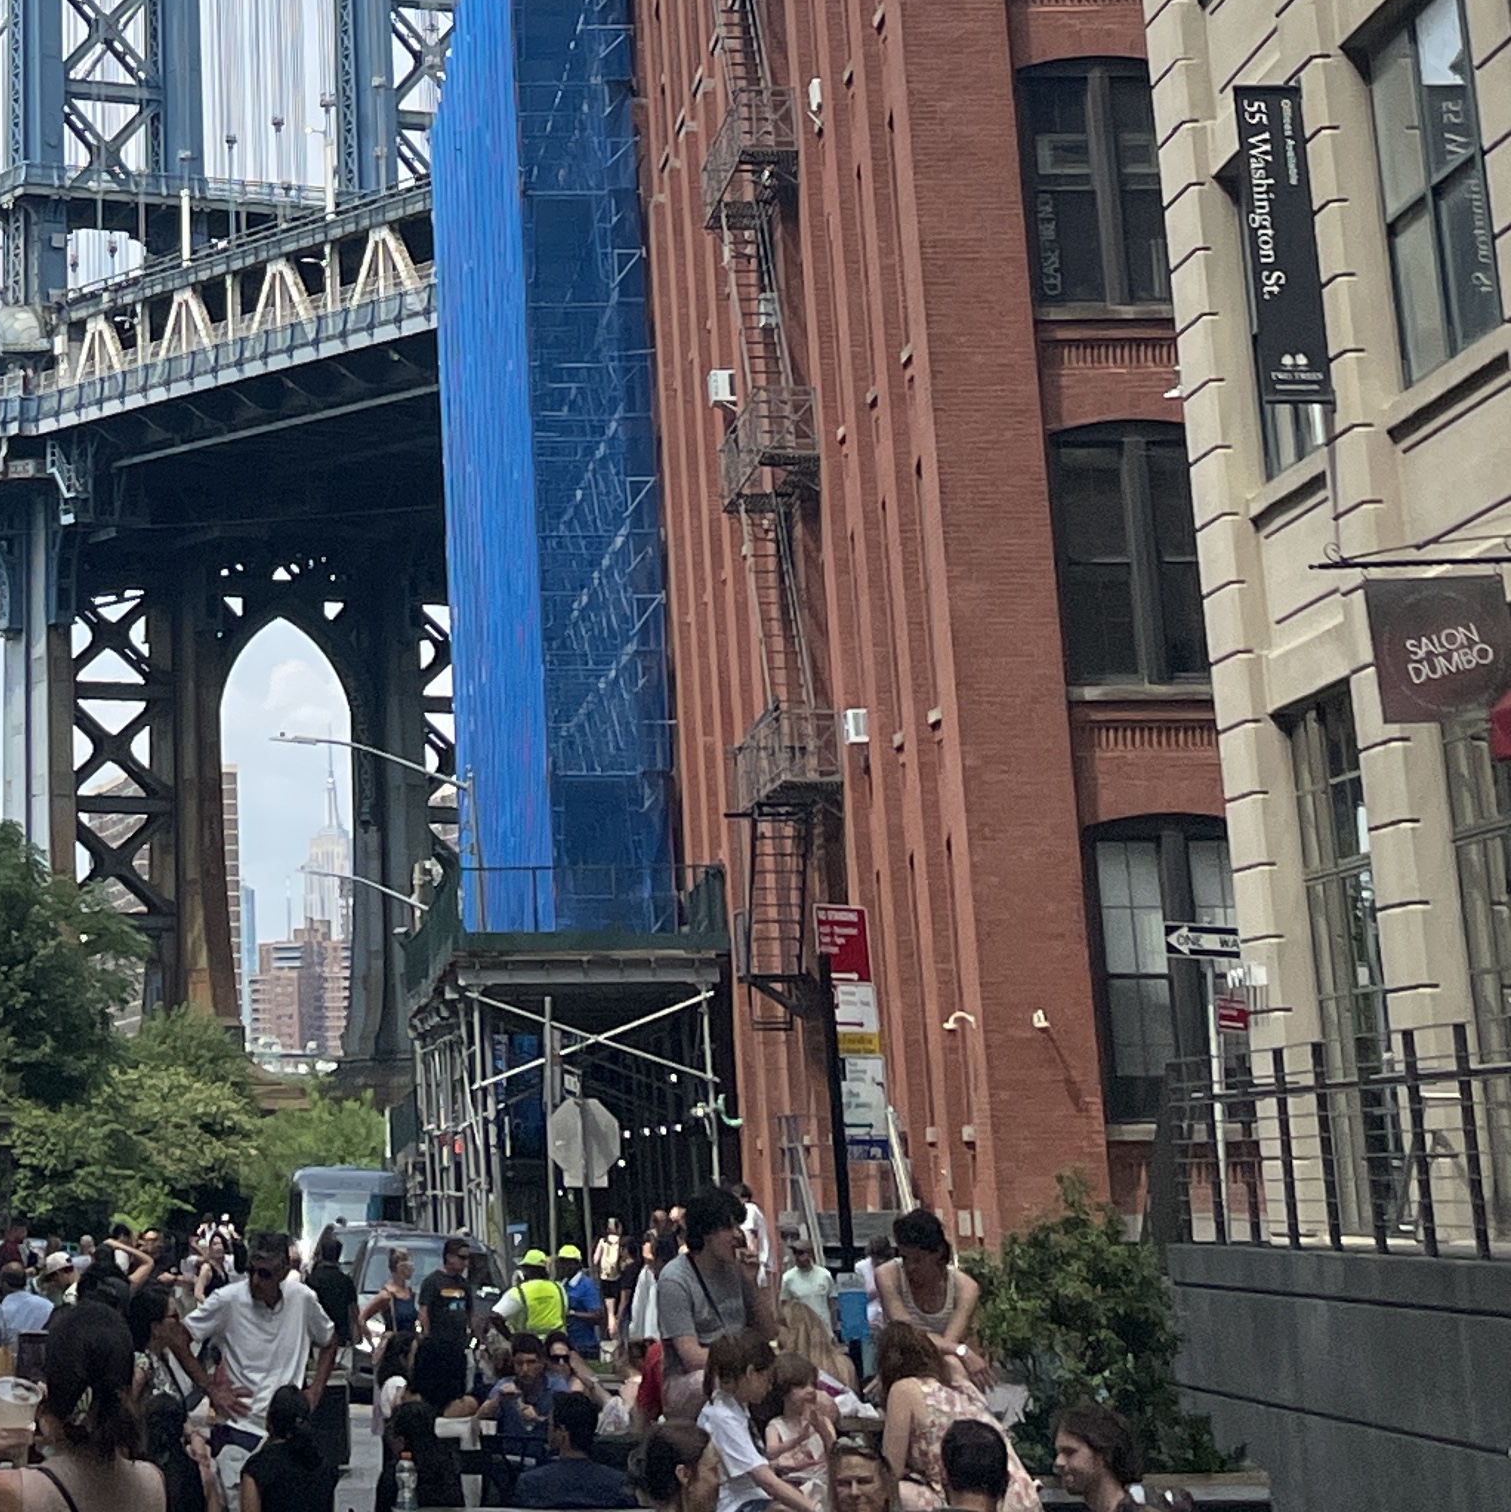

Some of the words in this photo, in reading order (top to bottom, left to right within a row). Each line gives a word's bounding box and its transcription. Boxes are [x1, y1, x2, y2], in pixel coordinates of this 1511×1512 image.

[1243, 99, 1268, 125] 55
[1247, 131, 1276, 264] Washington
[1261, 270, 1286, 300] St.
[1405, 622, 1480, 660] SALON
[1407, 643, 1494, 684] DUMBO
[1176, 934, 1203, 948] ONE
[1219, 936, 1239, 948] WA
